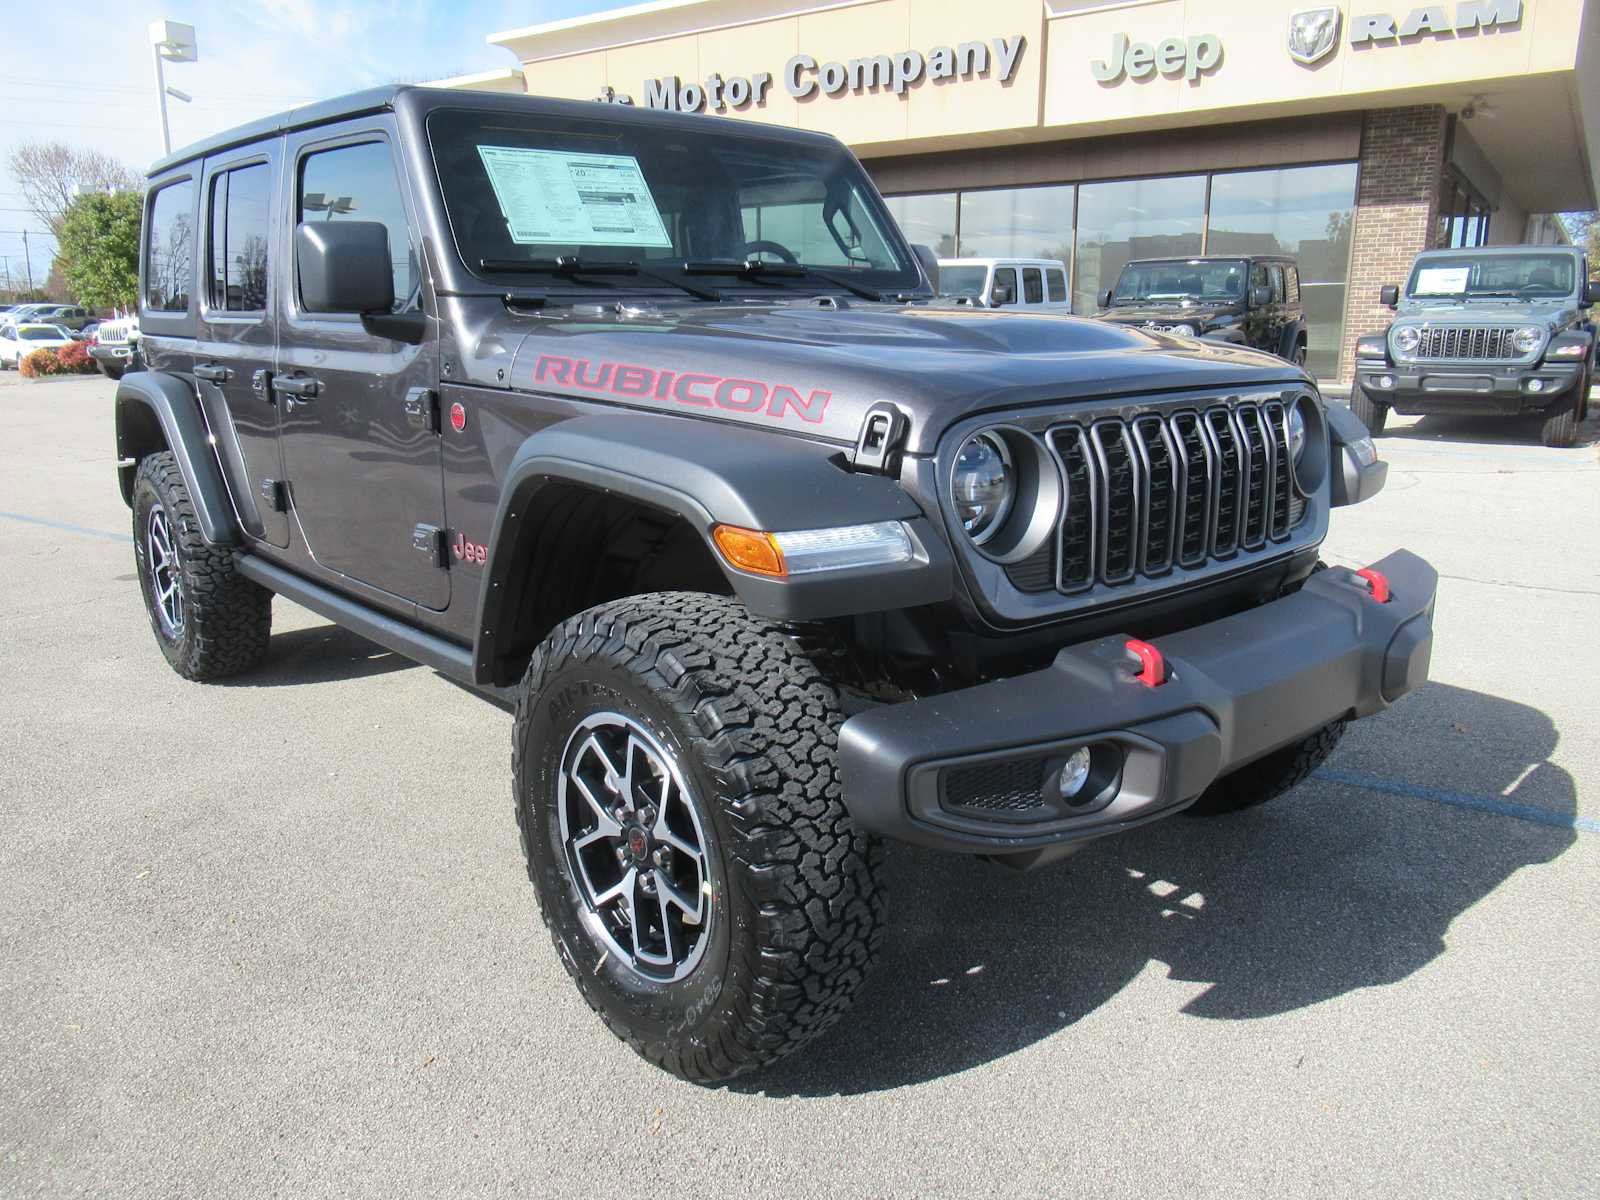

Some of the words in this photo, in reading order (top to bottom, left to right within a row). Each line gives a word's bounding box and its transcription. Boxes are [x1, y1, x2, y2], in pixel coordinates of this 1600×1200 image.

[1351, 0, 1523, 46] RAM
[643, 72, 770, 113] Motor
[784, 34, 1026, 100] Company
[1091, 33, 1223, 85] Jeep
[534, 354, 832, 425] RUBICON
[453, 531, 488, 566] Jee
